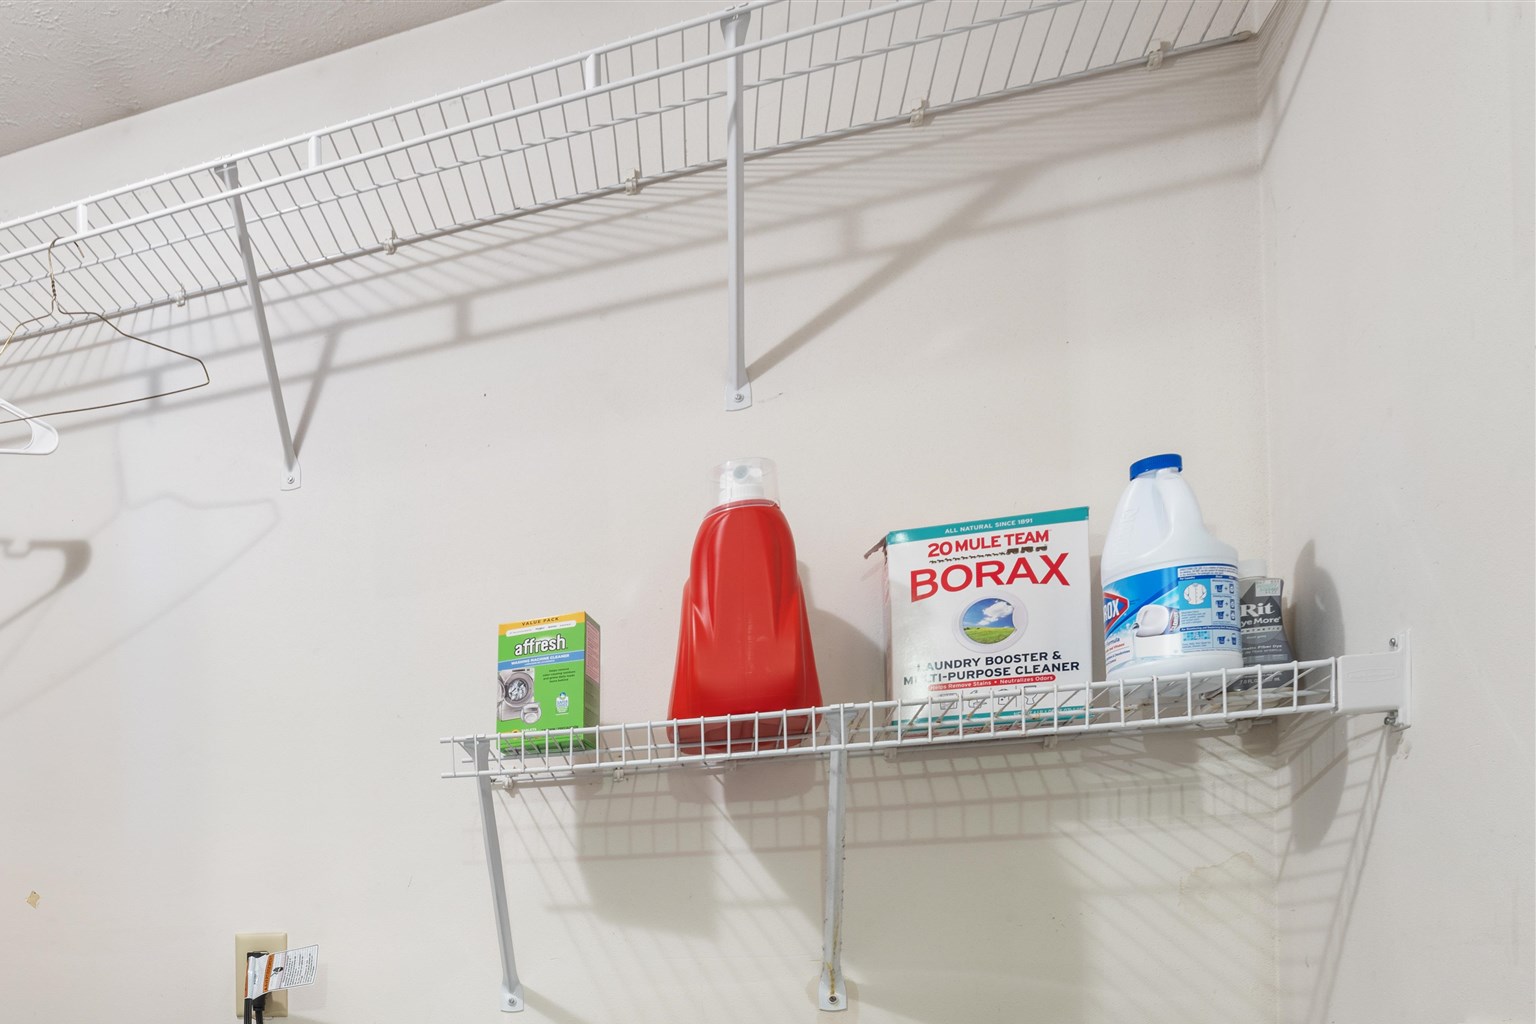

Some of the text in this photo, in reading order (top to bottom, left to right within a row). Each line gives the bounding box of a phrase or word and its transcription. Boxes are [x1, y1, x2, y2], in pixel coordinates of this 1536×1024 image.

[944, 526, 959, 534] ALL
[959, 522, 993, 533] NATURAL
[995, 519, 1016, 529] SINCE
[928, 529, 1049, 558] 20 MULE TEAM
[910, 552, 1070, 603] BORAX
[1240, 602, 1275, 618] Rit
[514, 634, 566, 656] affresh
[985, 652, 1048, 666] BOOSTER
[1052, 651, 1062, 660] &
[1015, 662, 1080, 675] CLEANER
[999, 677, 1034, 685] Neutralizes
